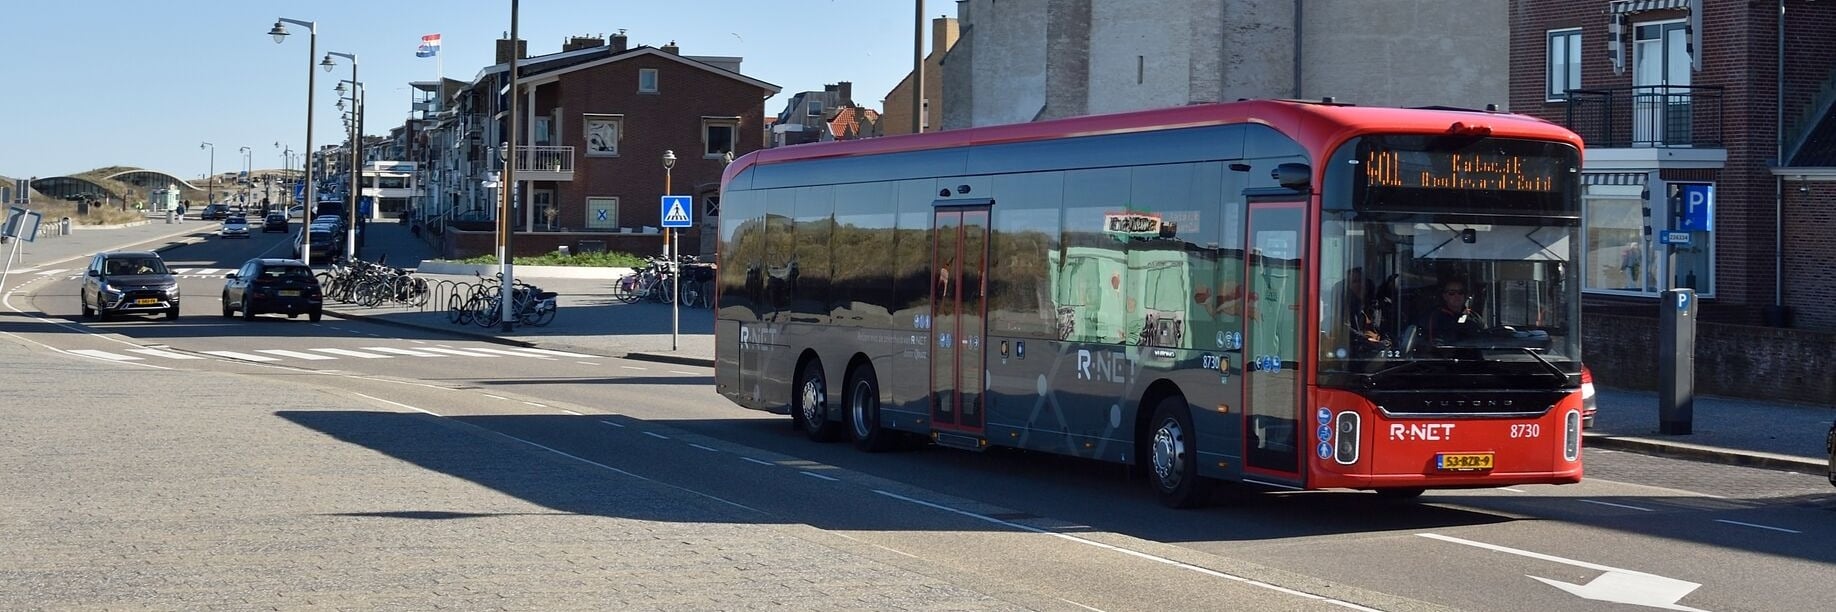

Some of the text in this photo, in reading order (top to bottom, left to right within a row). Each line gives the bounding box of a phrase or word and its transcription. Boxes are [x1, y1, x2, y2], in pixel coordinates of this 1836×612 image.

[1689, 191, 1704, 213] P
[1678, 293, 1687, 307] P
[1203, 355, 1219, 369] 8730
[1510, 423, 1540, 438] 8730
[1446, 455, 1490, 467] 53-BZR-9
